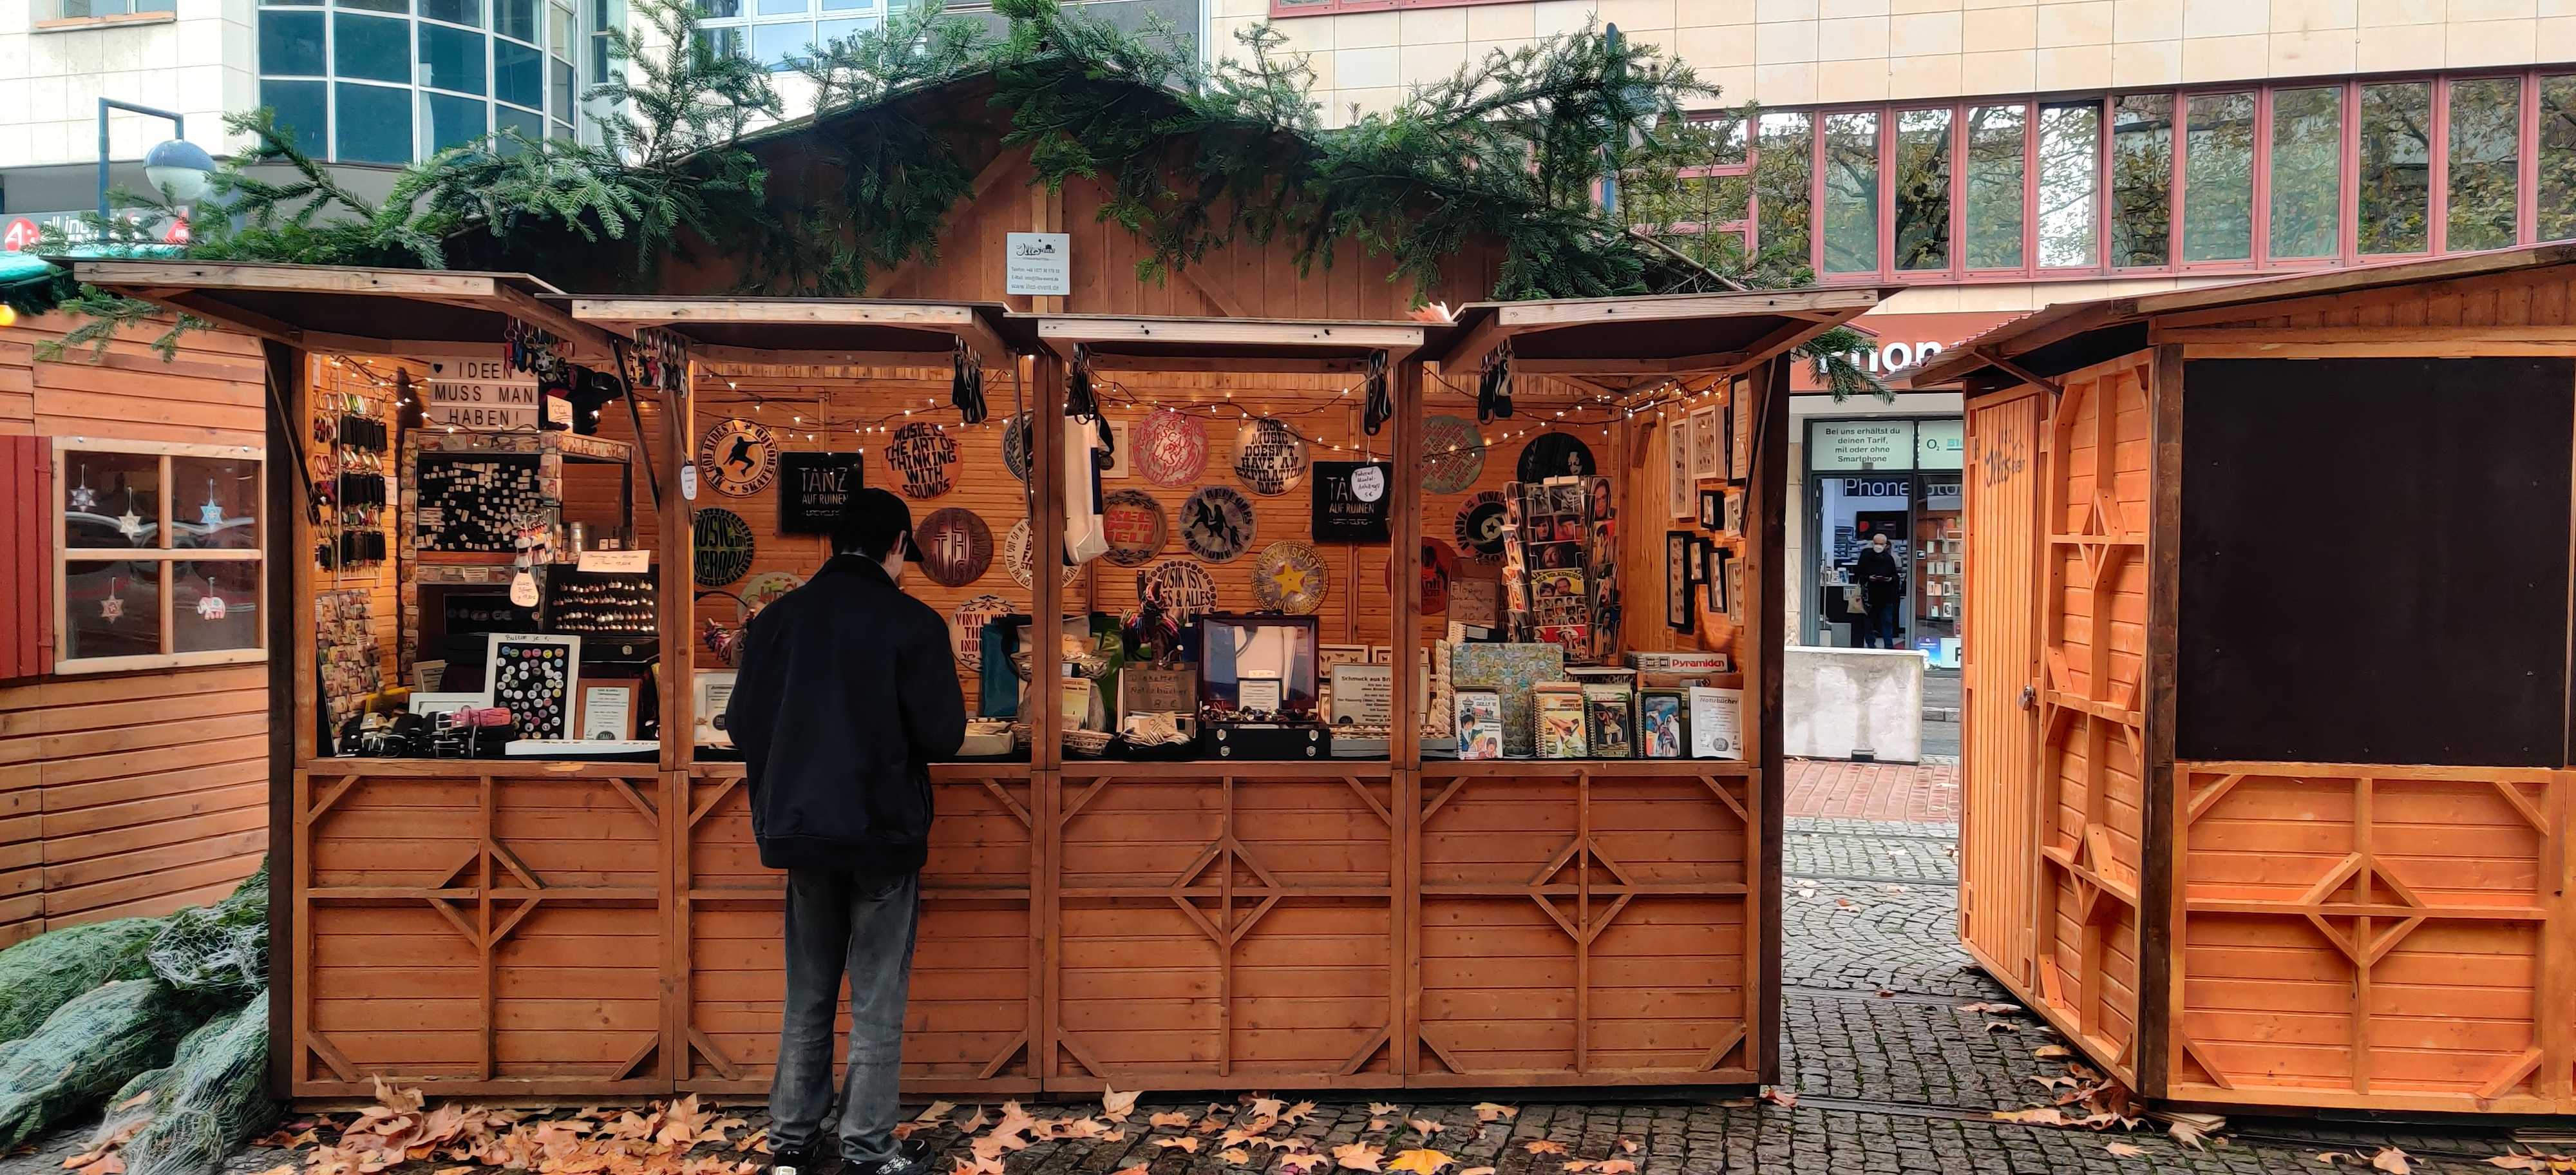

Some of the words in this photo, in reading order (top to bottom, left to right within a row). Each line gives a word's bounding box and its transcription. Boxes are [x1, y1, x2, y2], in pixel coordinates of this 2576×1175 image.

[459, 362, 512, 379] IDEEN
[435, 385, 482, 401] MUSS
[498, 387, 533, 403] MAN
[893, 422, 929, 444] MUSIC
[929, 423, 945, 437] IS
[1257, 419, 1283, 432] GOOD
[704, 425, 729, 451] RIDES
[1251, 432, 1288, 444] MUSIC
[884, 441, 908, 459] THE
[913, 437, 936, 452] ART
[940, 437, 958, 450] OF
[1245, 444, 1294, 457] DOESN'T
[703, 453, 715, 473] GOD
[742, 428, 776, 493] SKATEBOARD
[888, 450, 957, 471] THINKING
[1241, 457, 1274, 469] HAVE
[1280, 457, 1298, 468] AN
[798, 467, 849, 492] TANZ
[905, 465, 943, 484] WITH
[1234, 466, 1306, 481] EXPIRATION
[902, 477, 951, 499] SOUNDS
[1257, 481, 1285, 495] DATE
[1844, 478, 1909, 496] Phone
[802, 493, 817, 504] AUF
[819, 493, 849, 504] RUINEN
[1329, 502, 1344, 513] AUF
[1346, 502, 1374, 513] RUINEN
[1186, 568, 1202, 589] IST
[1176, 590, 1182, 607] &
[1185, 591, 1211, 607] ALLES
[1672, 658, 1725, 667] Pyramiden
